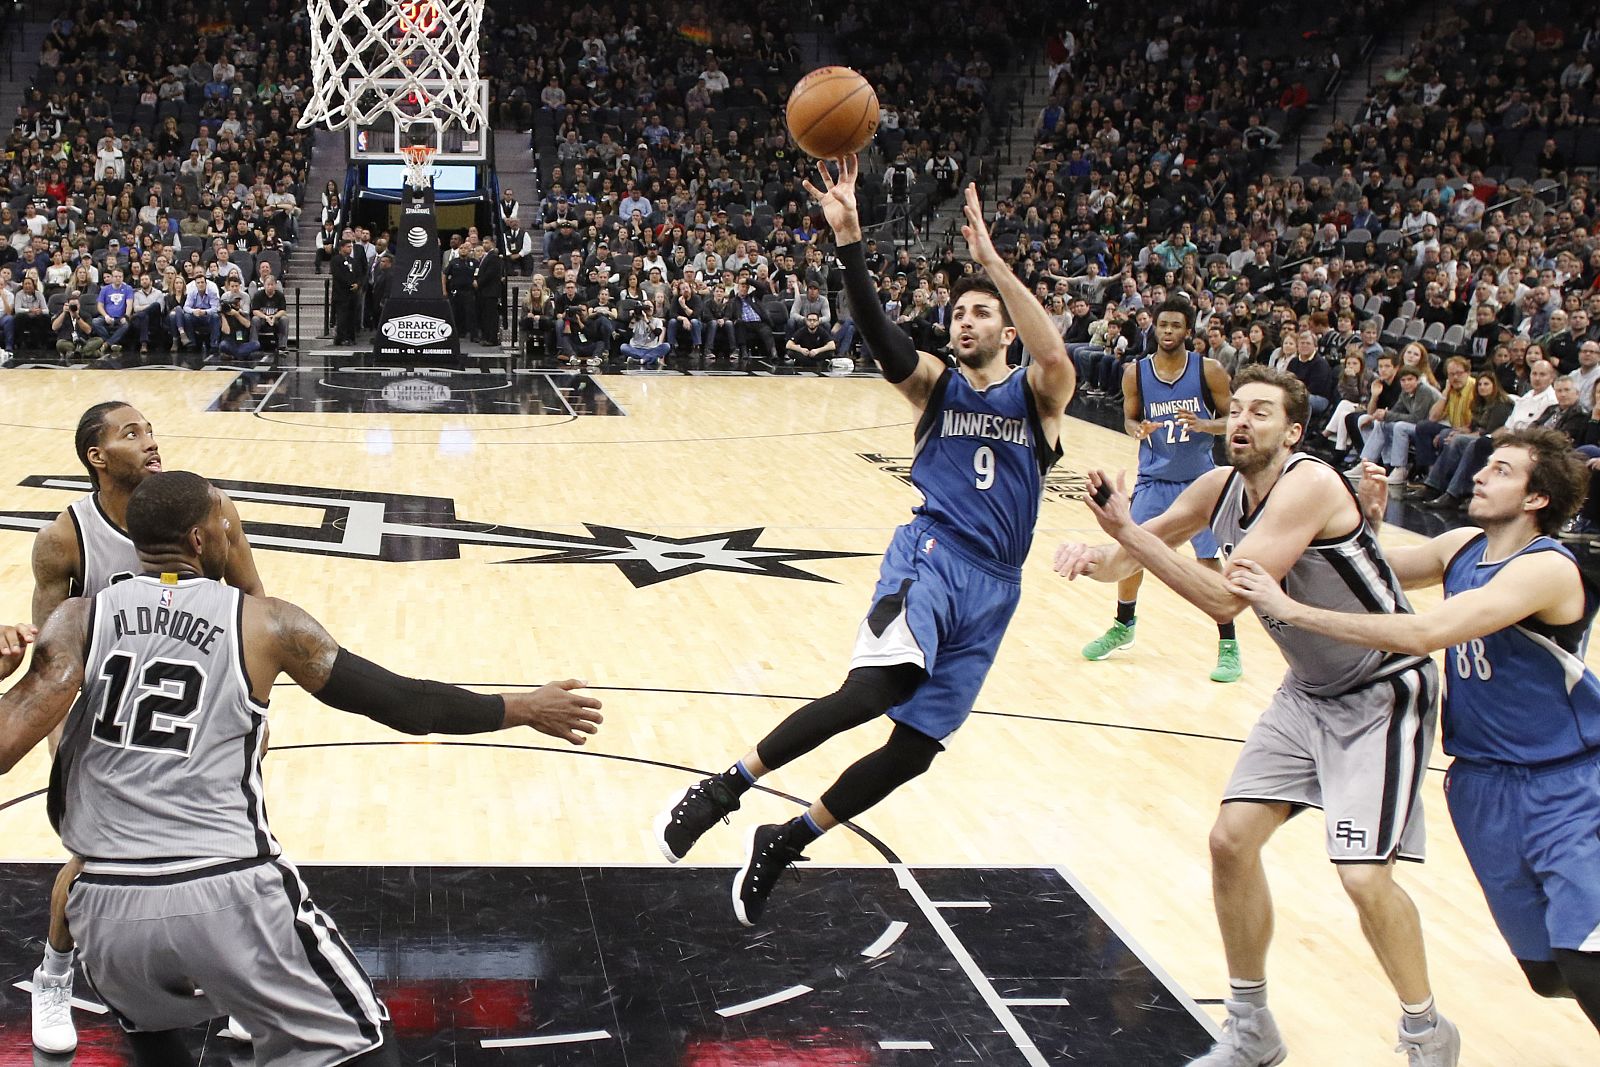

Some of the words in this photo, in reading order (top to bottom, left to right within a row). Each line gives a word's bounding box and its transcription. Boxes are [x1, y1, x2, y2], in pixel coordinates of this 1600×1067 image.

[397, 321, 437, 329] BRAKE
[397, 331, 436, 339] CHECK
[1150, 396, 1201, 418] MINNESOTA
[940, 409, 1030, 448] MINNESOTA
[973, 445, 996, 490] 9
[1455, 637, 1492, 681] 88
[91, 650, 208, 758] 12
[1335, 819, 1367, 849] SA
